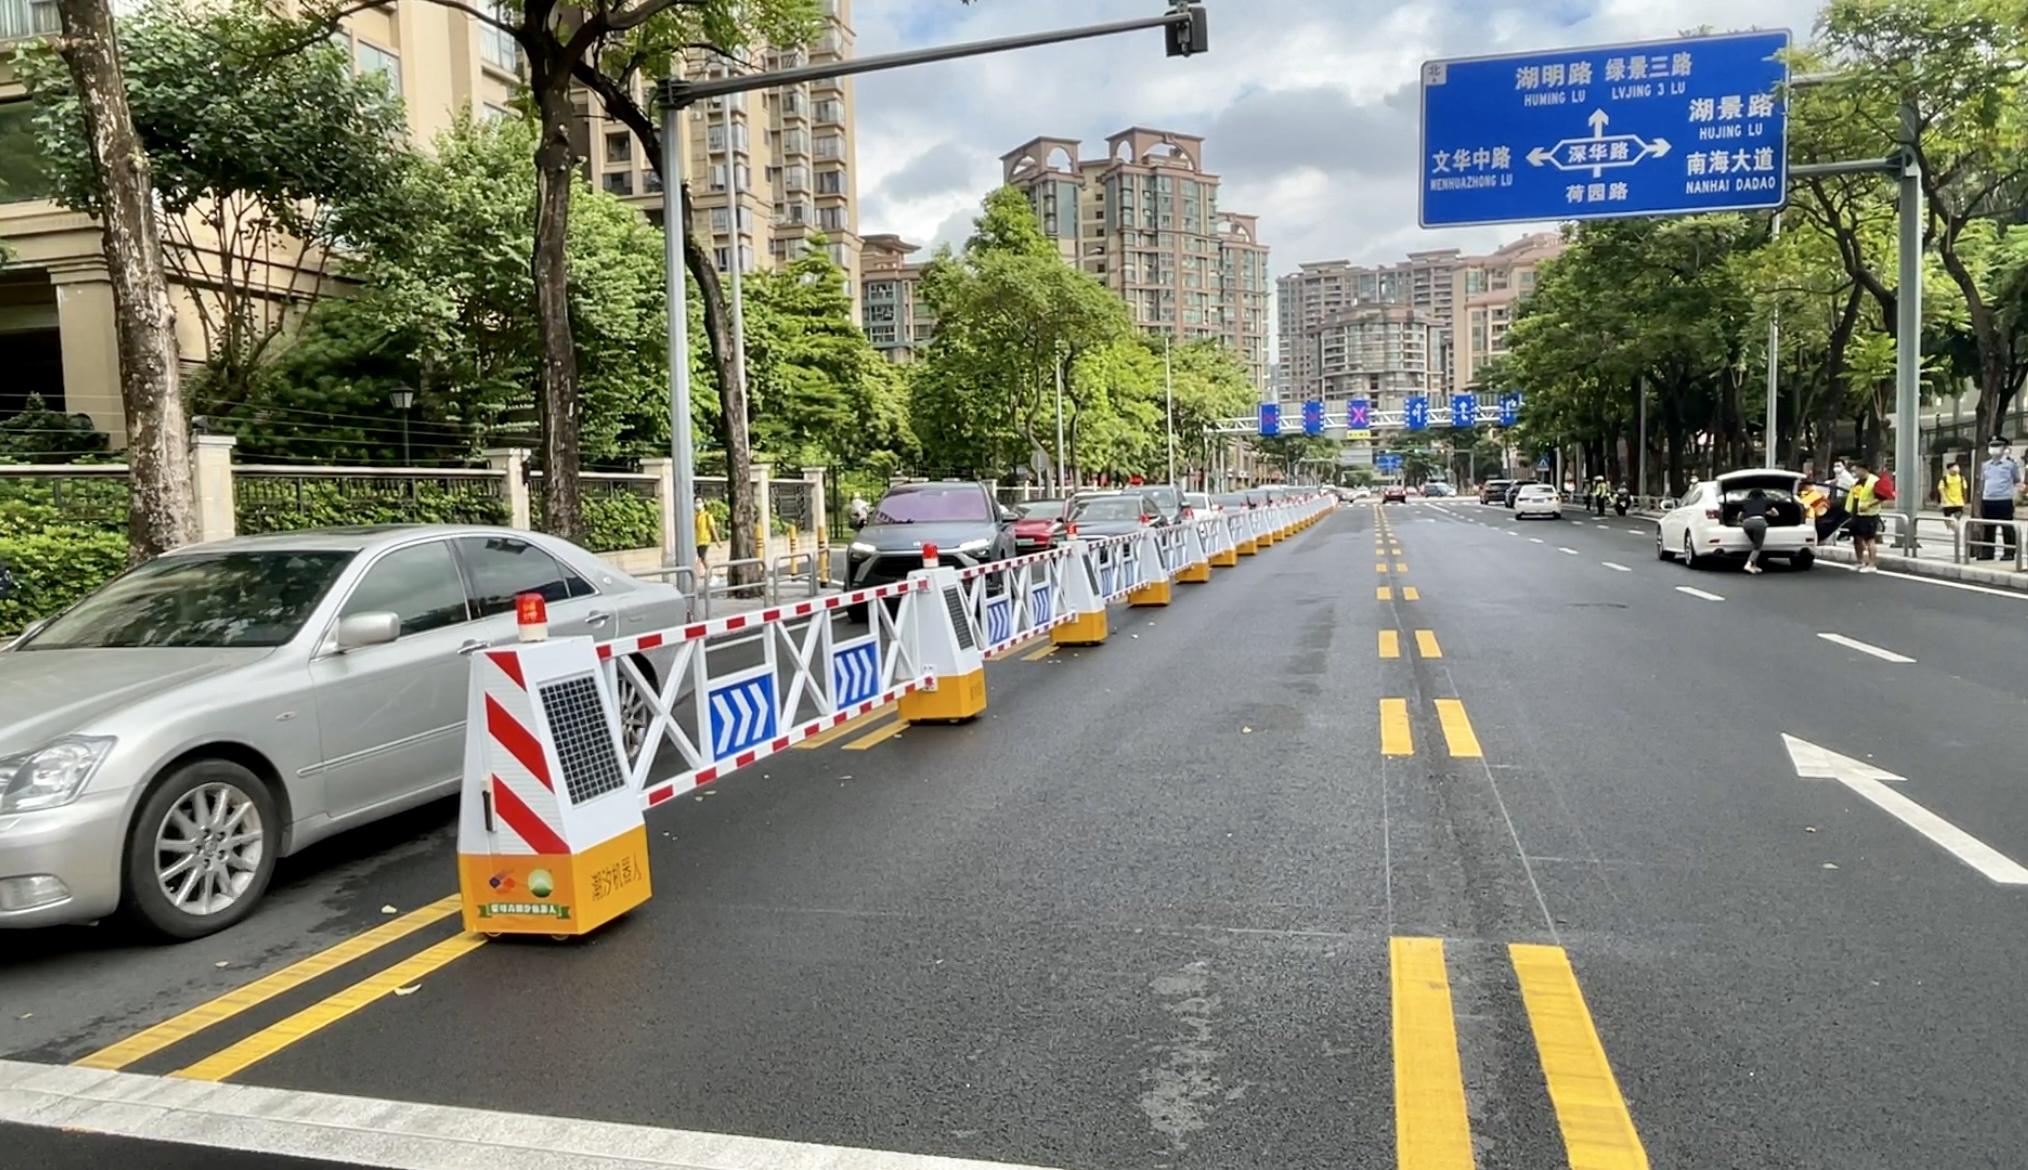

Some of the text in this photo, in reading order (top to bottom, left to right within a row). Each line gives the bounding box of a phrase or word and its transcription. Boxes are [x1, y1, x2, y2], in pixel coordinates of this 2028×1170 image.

[1515, 61, 1593, 90] 湖明路
[1604, 51, 1693, 82] 绿景三路
[1524, 90, 1586, 107] HUMING LU
[1611, 81, 1686, 100] LVJING 3 LU
[1689, 93, 1775, 122] 湖景路
[1699, 122, 1763, 140] HUJING LU
[1432, 146, 1511, 174] 文华中路
[1568, 141, 1629, 163] 深华路
[1686, 146, 1774, 176] 南海大道
[1430, 173, 1513, 191] WENHUAZHONG LU
[1566, 181, 1629, 203] 荷园路
[1686, 176, 1776, 194] NANHAI DADAO
